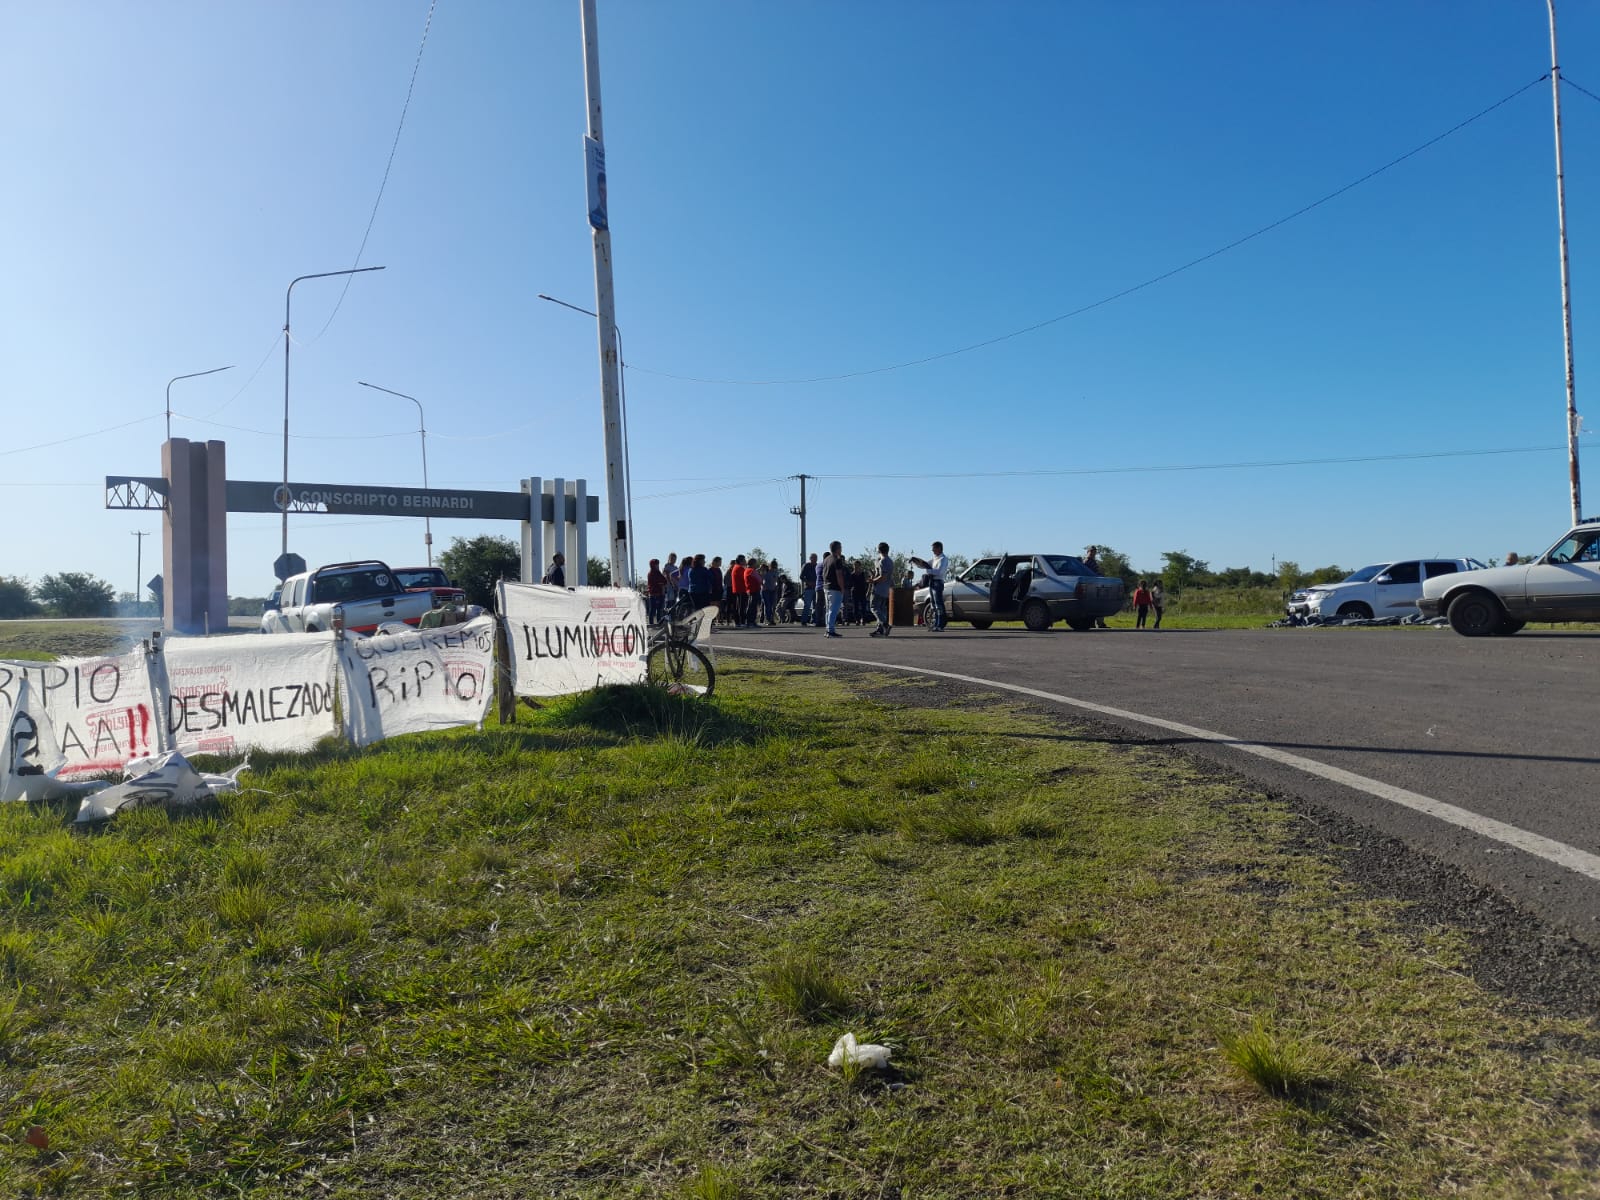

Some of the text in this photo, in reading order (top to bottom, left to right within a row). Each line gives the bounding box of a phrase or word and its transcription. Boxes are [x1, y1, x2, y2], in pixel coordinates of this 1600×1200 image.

[300, 489, 474, 509] CONSCRIPTO BERNARDI
[0, 663, 120, 709] RPIO
